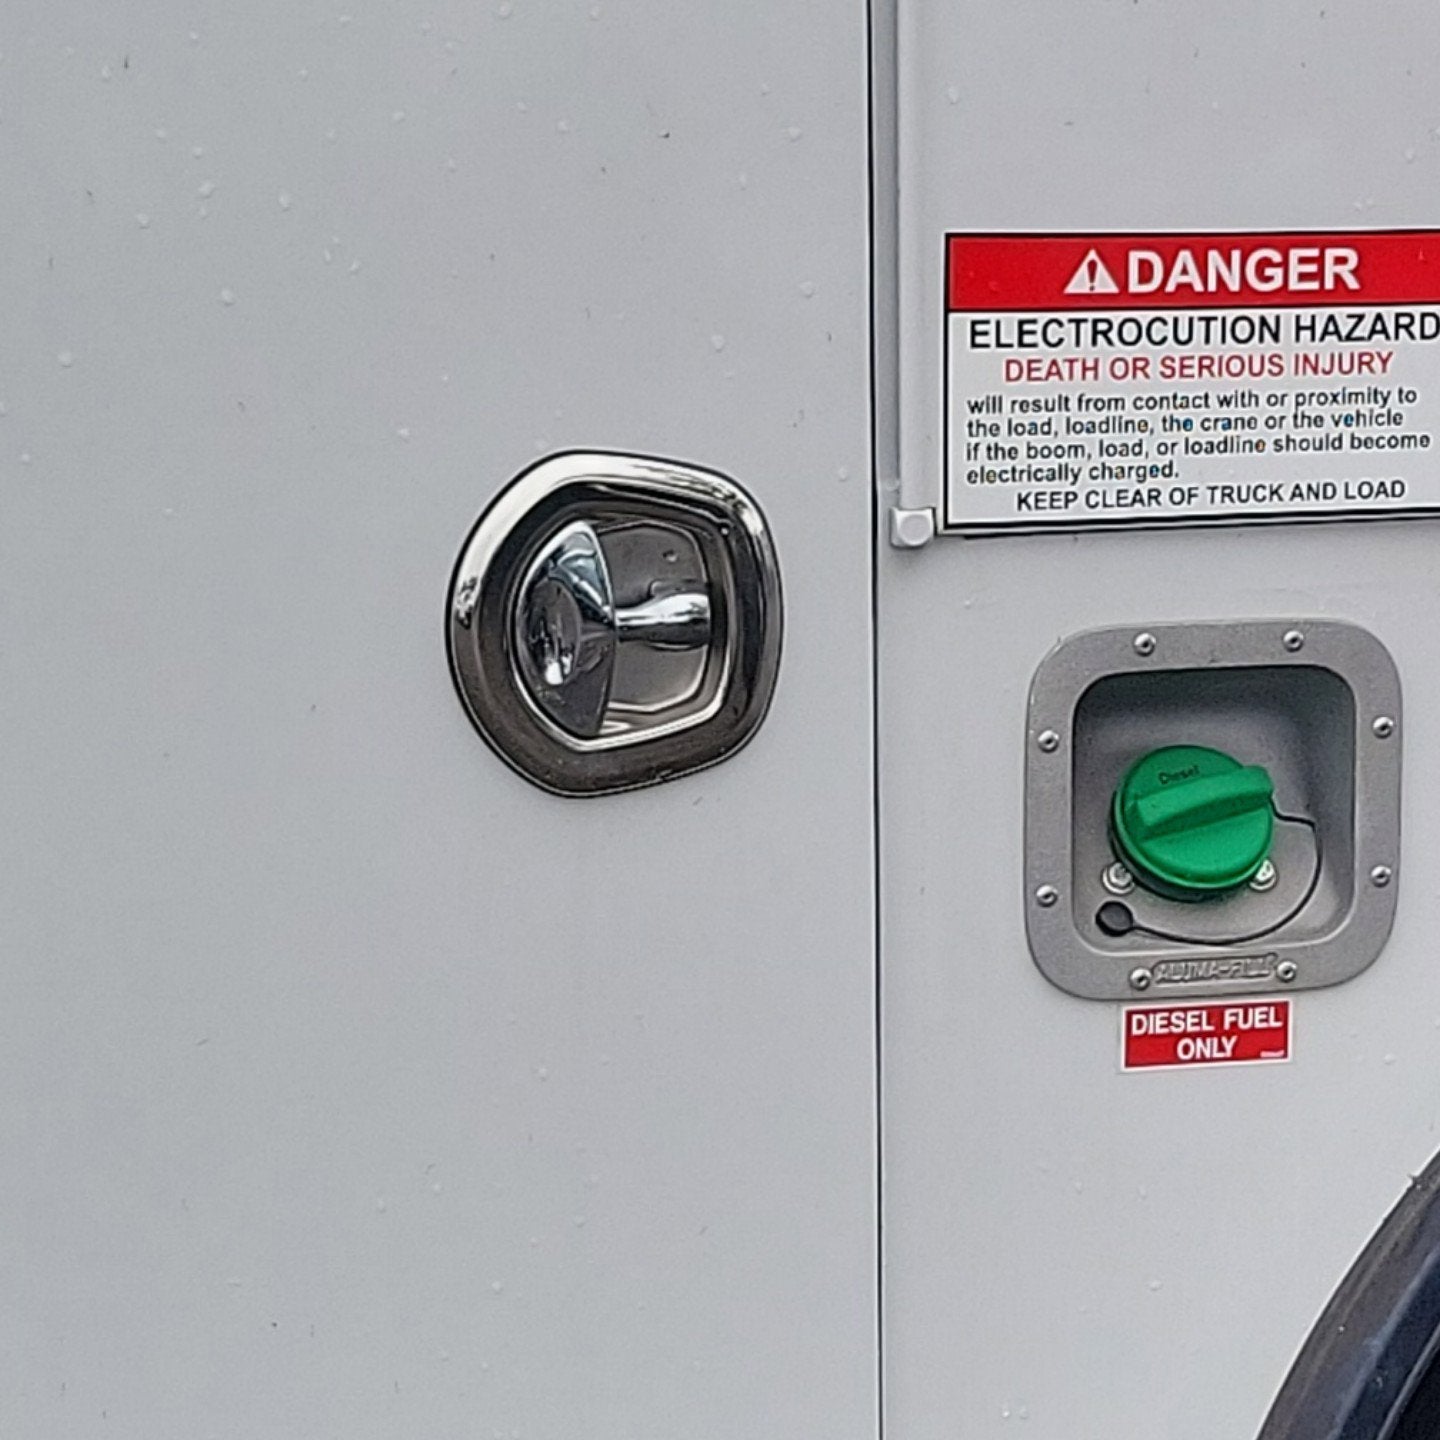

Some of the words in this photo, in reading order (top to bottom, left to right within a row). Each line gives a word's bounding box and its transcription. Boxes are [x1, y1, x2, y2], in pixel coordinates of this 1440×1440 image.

[1127, 247, 1361, 293] DANGER
[969, 314, 1281, 349] ELECTROCUTION
[1004, 356, 1099, 382] DEATH
[1109, 355, 1150, 380] OR
[1159, 353, 1284, 380] SERIOUS
[1293, 351, 1393, 376] INJURY
[966, 395, 1003, 414] will
[1010, 394, 1070, 413] result
[1077, 392, 1126, 412] from
[1132, 390, 1211, 410] contact
[1217, 389, 1259, 408] with
[1266, 392, 1289, 408] or
[1293, 386, 1391, 410] proximity
[1397, 387, 1418, 404] to
[966, 419, 1001, 437] the
[1007, 417, 1059, 438] load,
[1065, 415, 1154, 436] loadline,
[1161, 415, 1194, 433] the
[1199, 414, 1258, 432] crane
[1264, 414, 1287, 430] or
[1292, 410, 1324, 429] the
[1330, 409, 1404, 428] vehicle
[966, 442, 981, 461] if
[986, 442, 1019, 461] the
[1026, 440, 1092, 461] boom,
[1099, 438, 1150, 459] load,
[1156, 441, 1179, 456] or
[1184, 435, 1266, 455] loadline
[1272, 432, 1344, 452] should
[1350, 432, 1431, 450] become
[966, 462, 1082, 486] electrically
[1088, 460, 1180, 484] charged.
[1017, 490, 1079, 511] KEEP
[1085, 488, 1162, 510] CLEAR
[1168, 486, 1200, 506] OF
[1207, 483, 1285, 504] TRUCK
[1289, 481, 1338, 501] AND
[1343, 479, 1406, 500] LOAD
[1130, 1009, 1215, 1036] DIESEL
[1223, 1006, 1284, 1031] FUEL
[1176, 1035, 1238, 1061] ONLY
